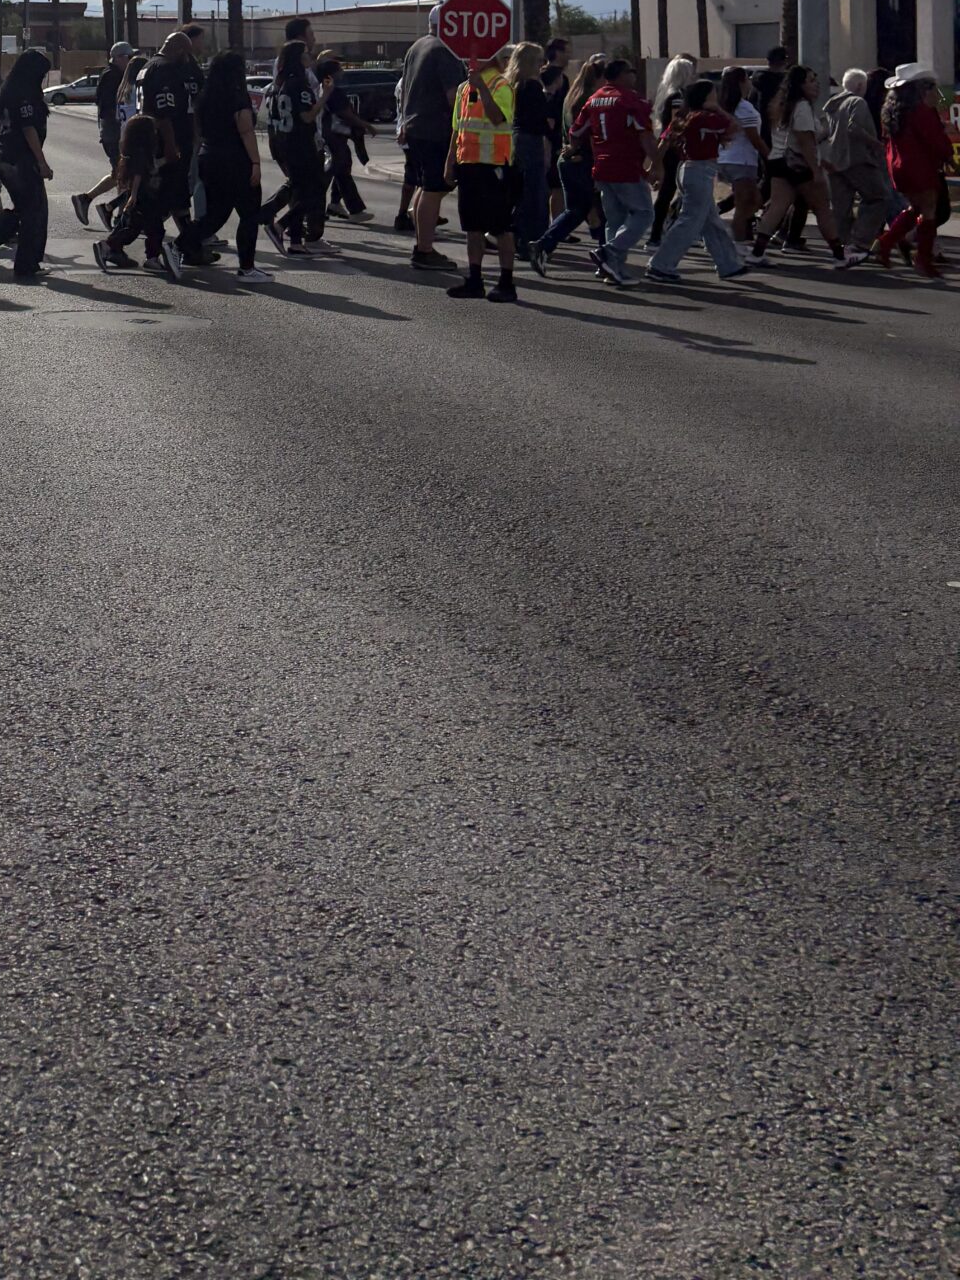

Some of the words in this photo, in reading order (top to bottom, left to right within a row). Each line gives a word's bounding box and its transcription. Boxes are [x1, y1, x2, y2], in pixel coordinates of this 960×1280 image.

[443, 11, 507, 38] STOP
[155, 92, 176, 109] 29
[591, 96, 619, 107] MURRAY
[599, 112, 608, 141] 1
